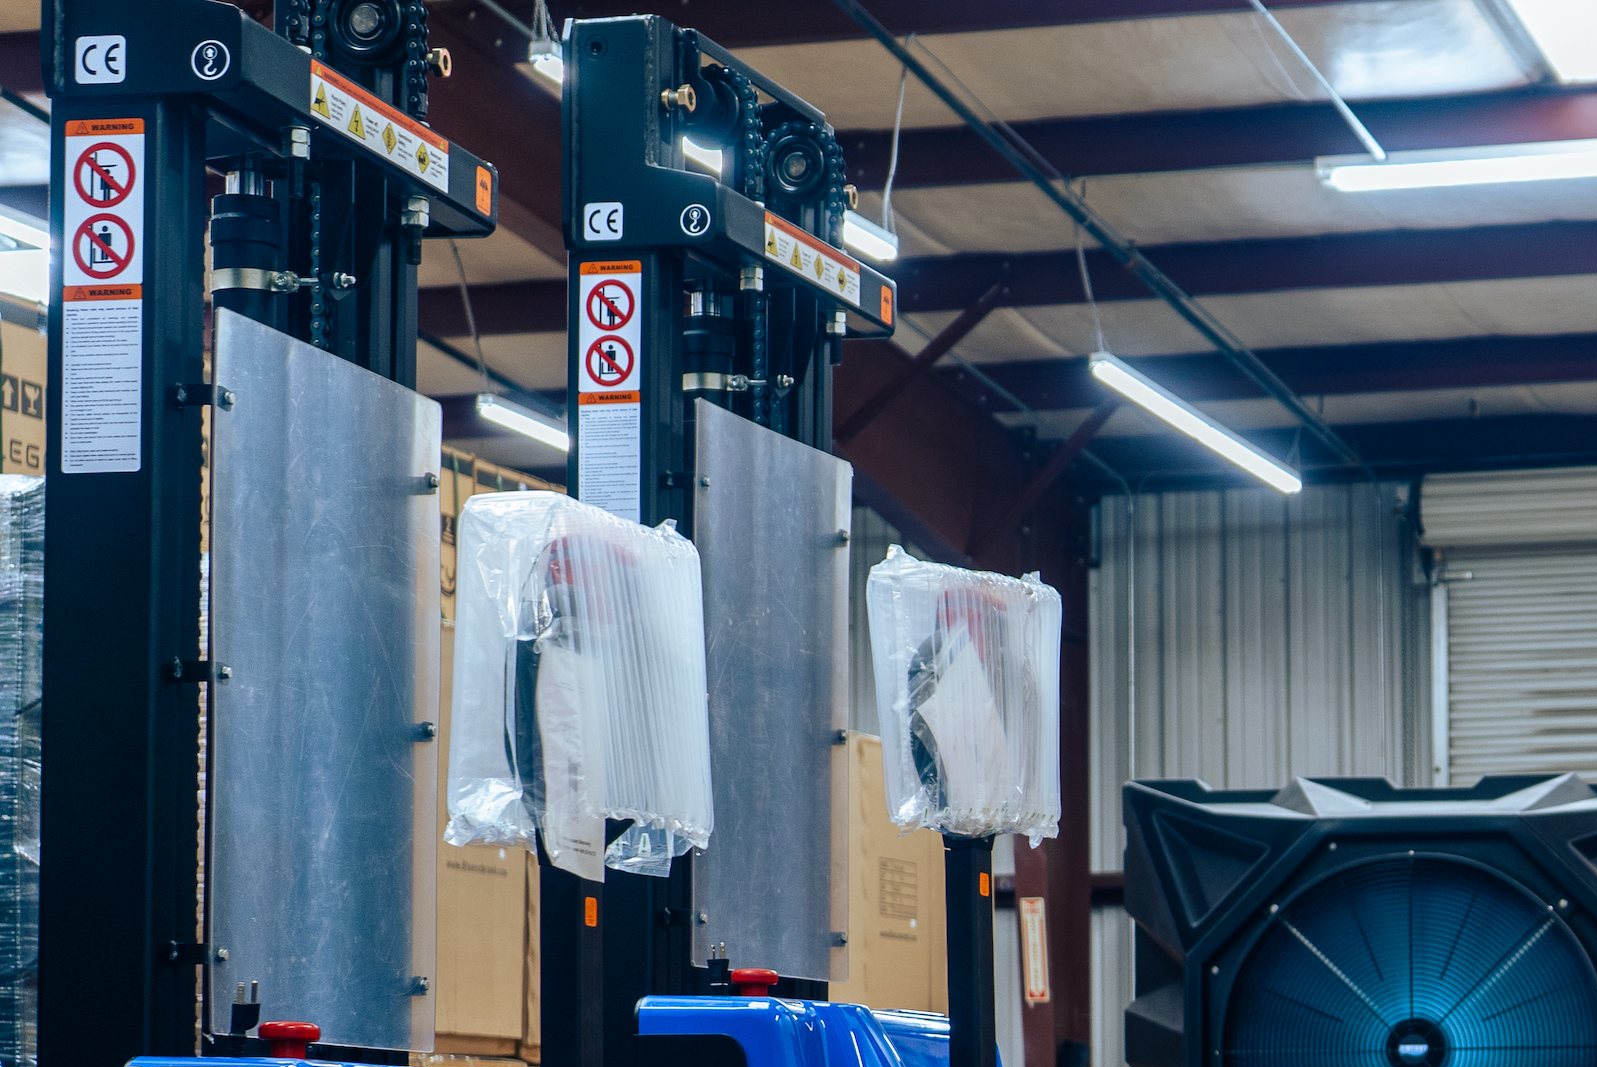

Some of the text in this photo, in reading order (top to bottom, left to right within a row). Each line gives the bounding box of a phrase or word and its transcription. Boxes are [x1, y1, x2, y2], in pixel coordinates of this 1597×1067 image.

[82, 43, 120, 76] CE
[91, 123, 134, 131] WARNING
[589, 208, 618, 234] CE
[89, 288, 132, 296] WARNING
[598, 393, 632, 401] WARNING
